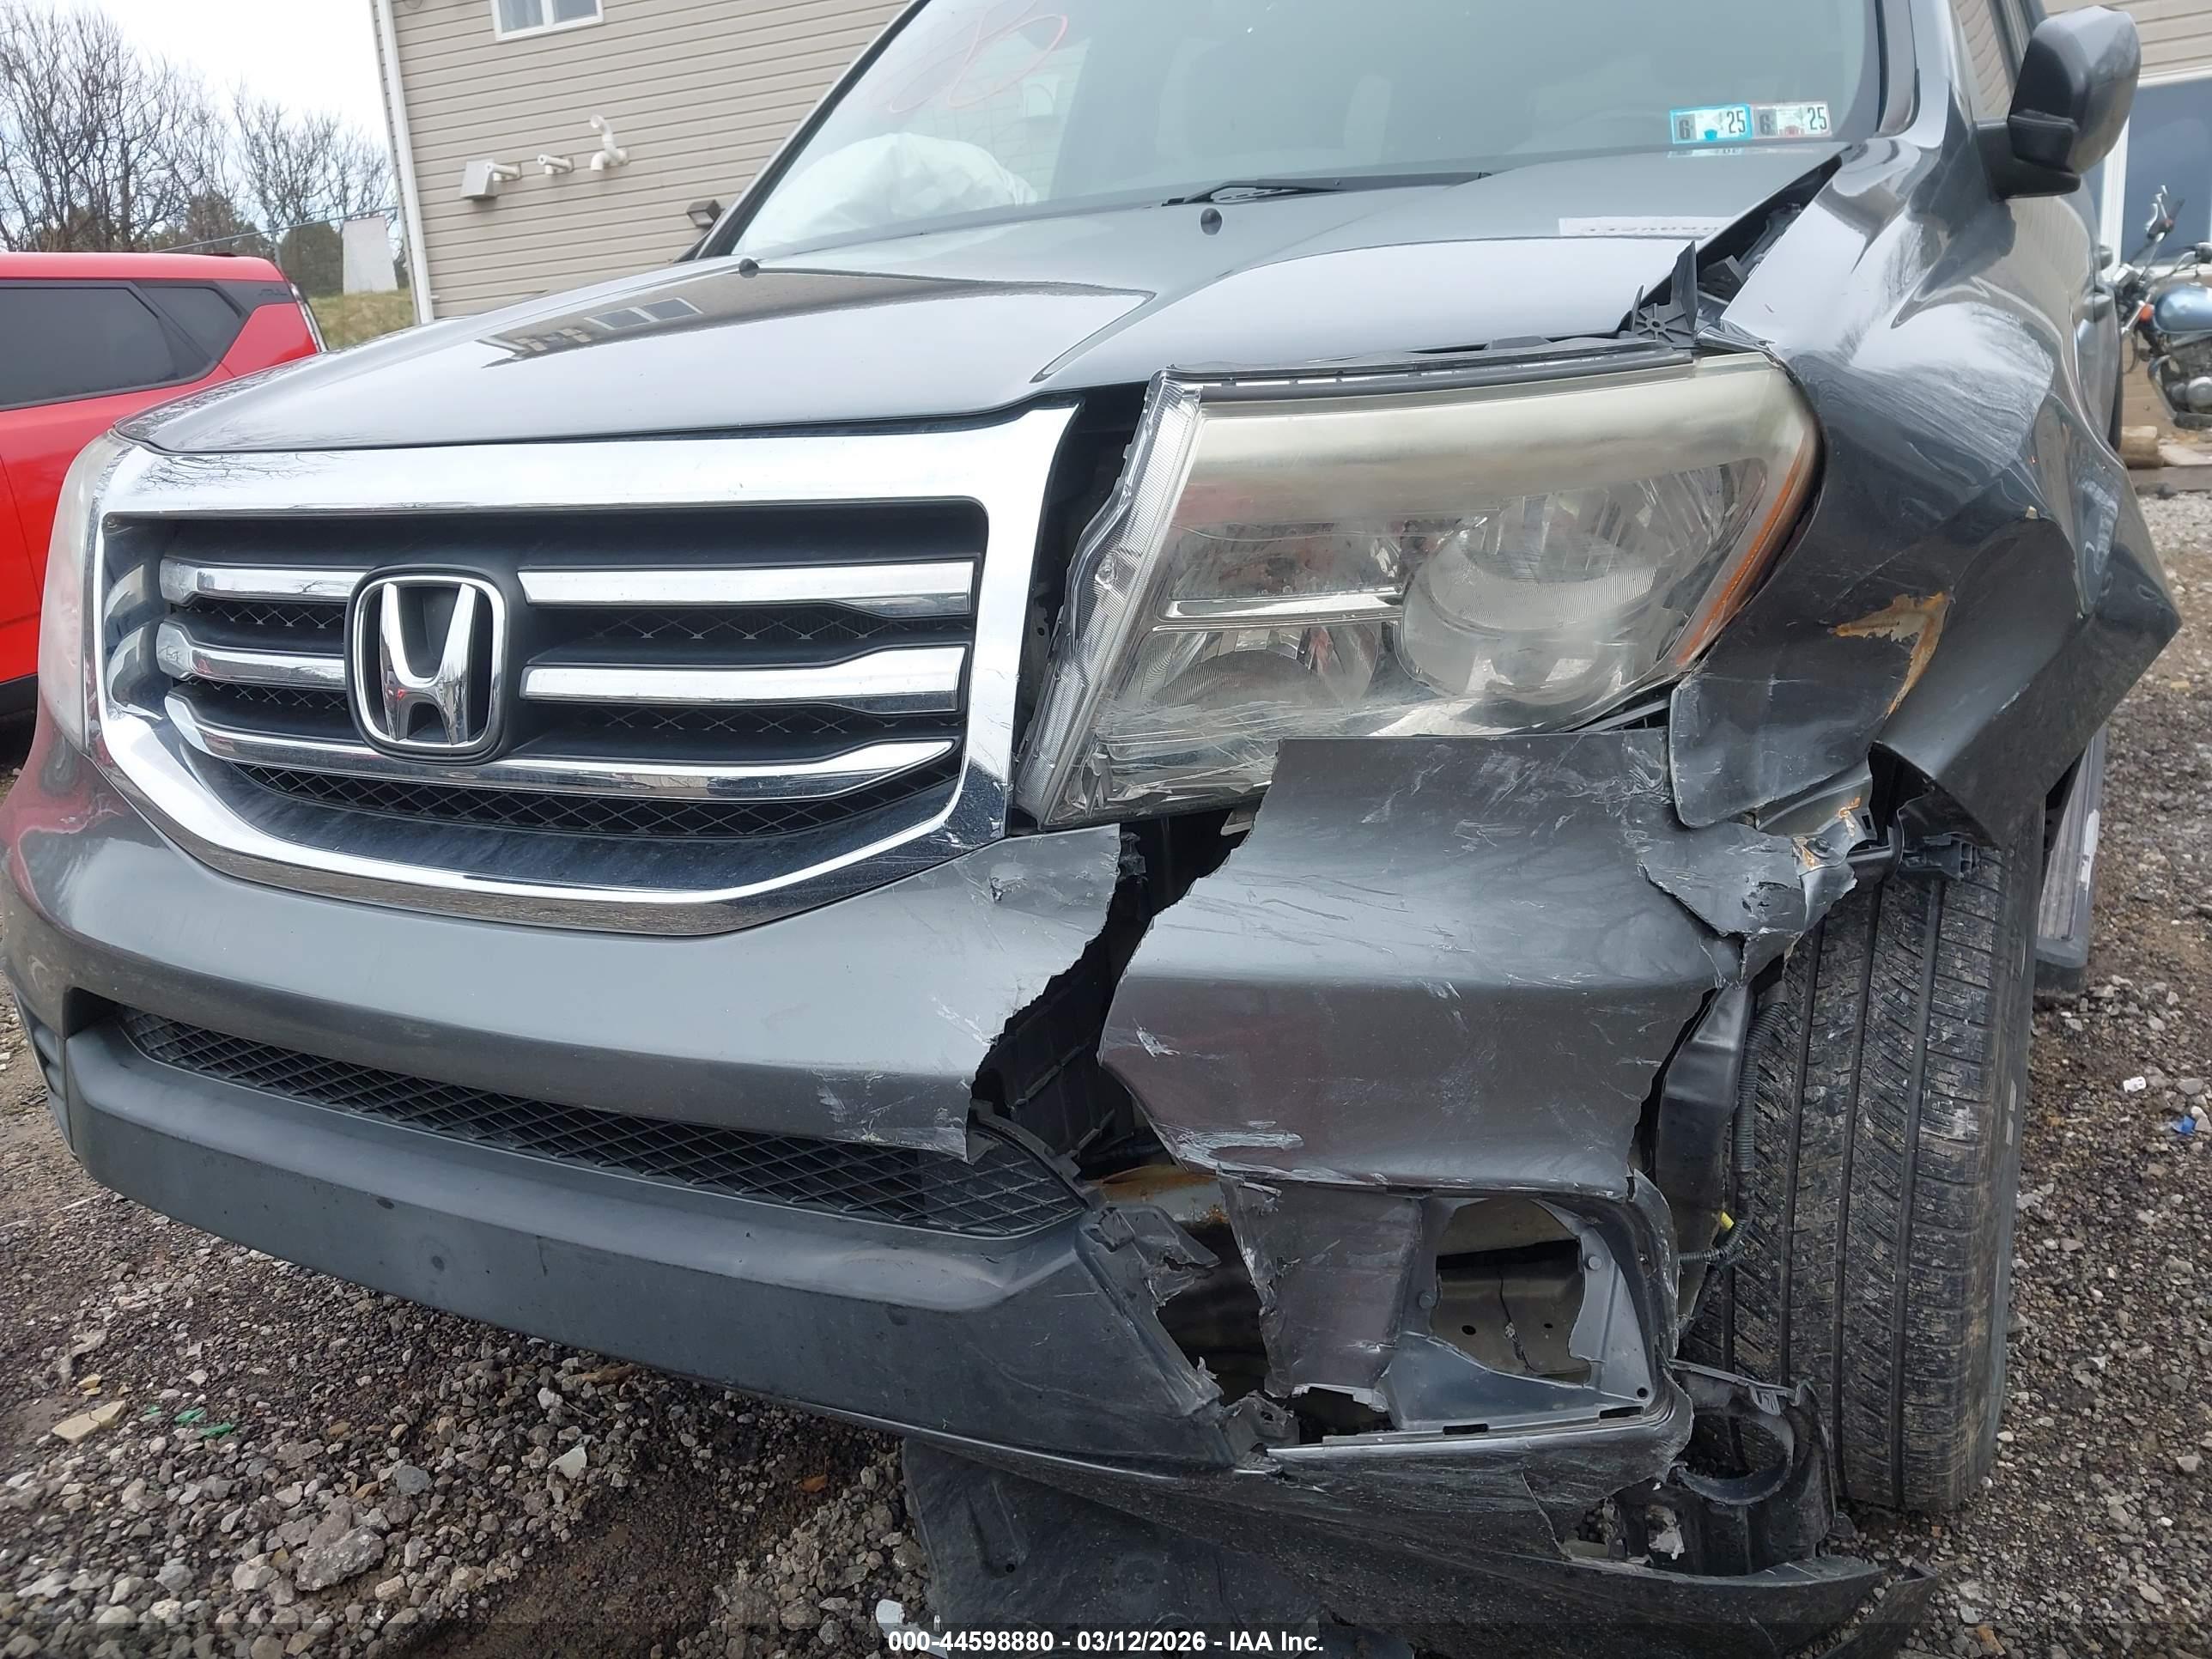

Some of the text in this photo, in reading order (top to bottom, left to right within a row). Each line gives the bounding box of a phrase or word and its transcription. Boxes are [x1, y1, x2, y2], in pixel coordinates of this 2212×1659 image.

[1678, 110, 1747, 140] 6 25
[1759, 106, 1828, 137] 6 25
